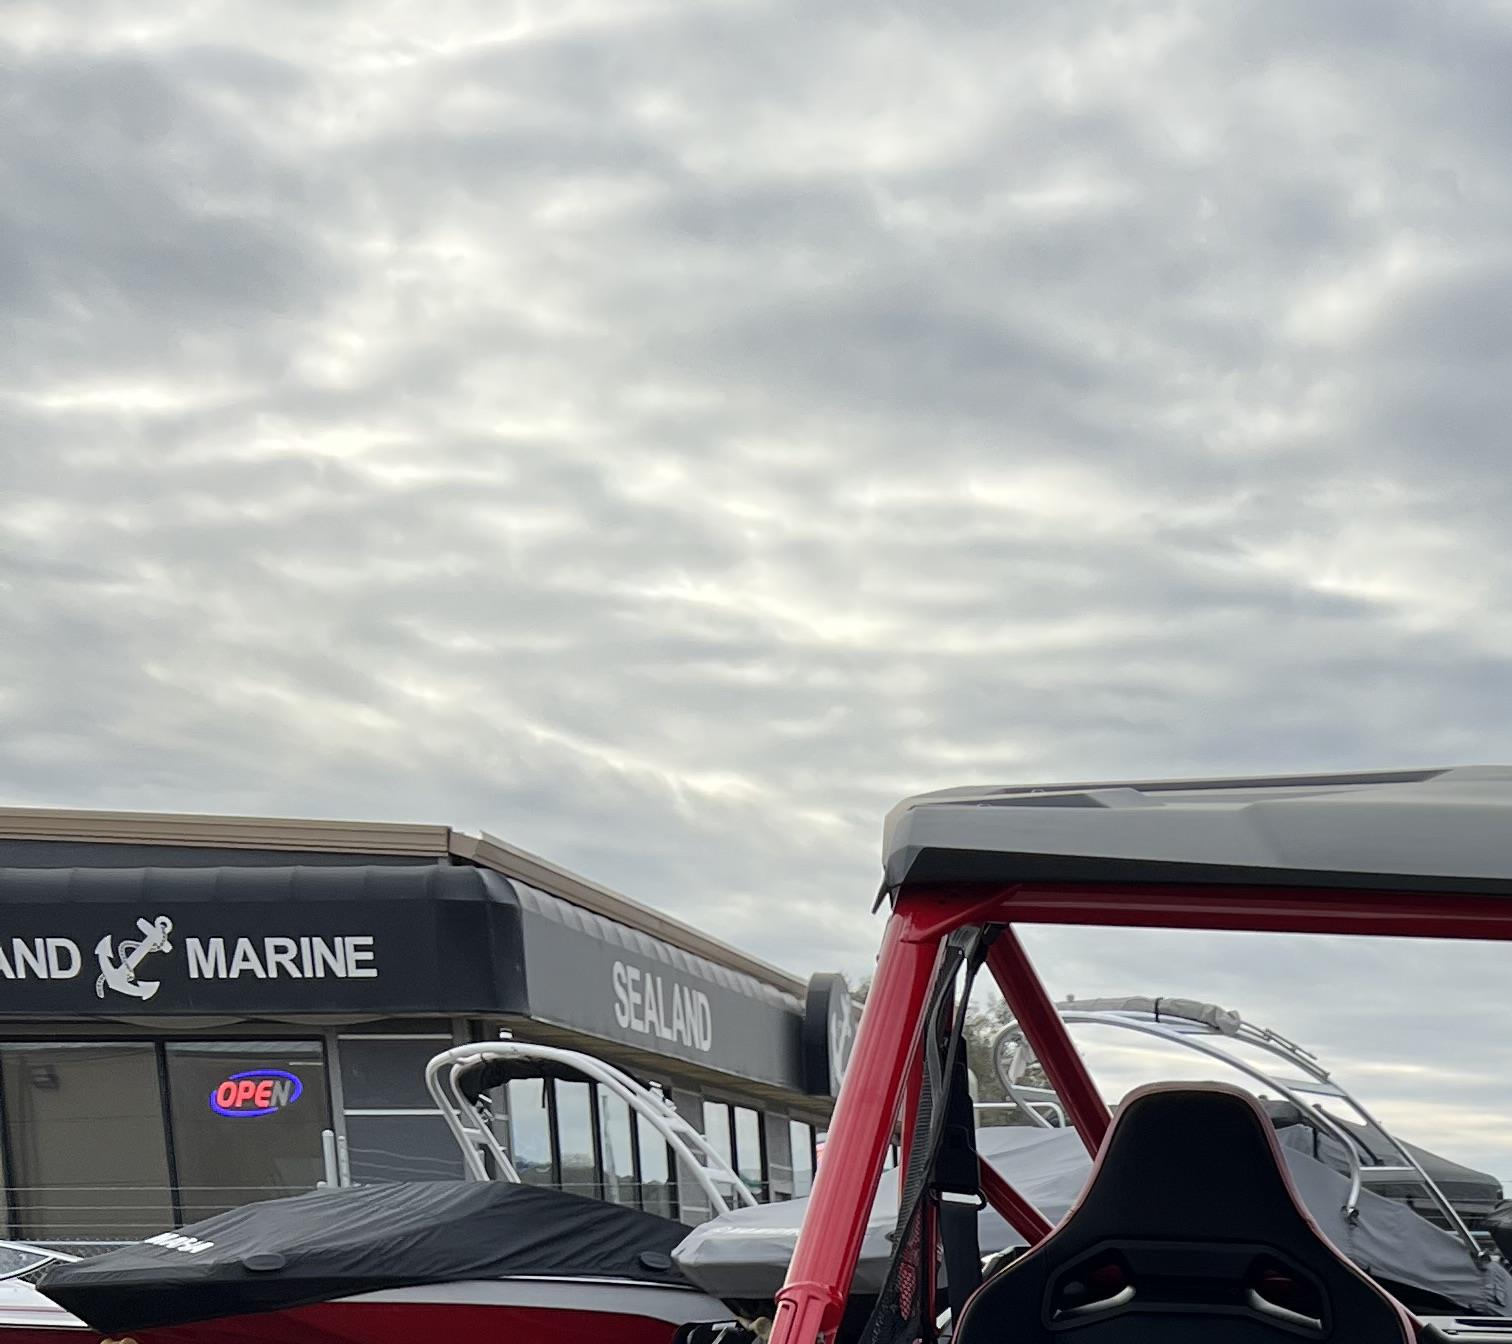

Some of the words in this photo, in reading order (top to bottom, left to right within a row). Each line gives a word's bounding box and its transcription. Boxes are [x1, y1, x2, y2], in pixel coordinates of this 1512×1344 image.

[185, 936, 378, 979] MARINE
[613, 960, 712, 1052] SEALAND
[217, 1080, 291, 1108] OPEN
